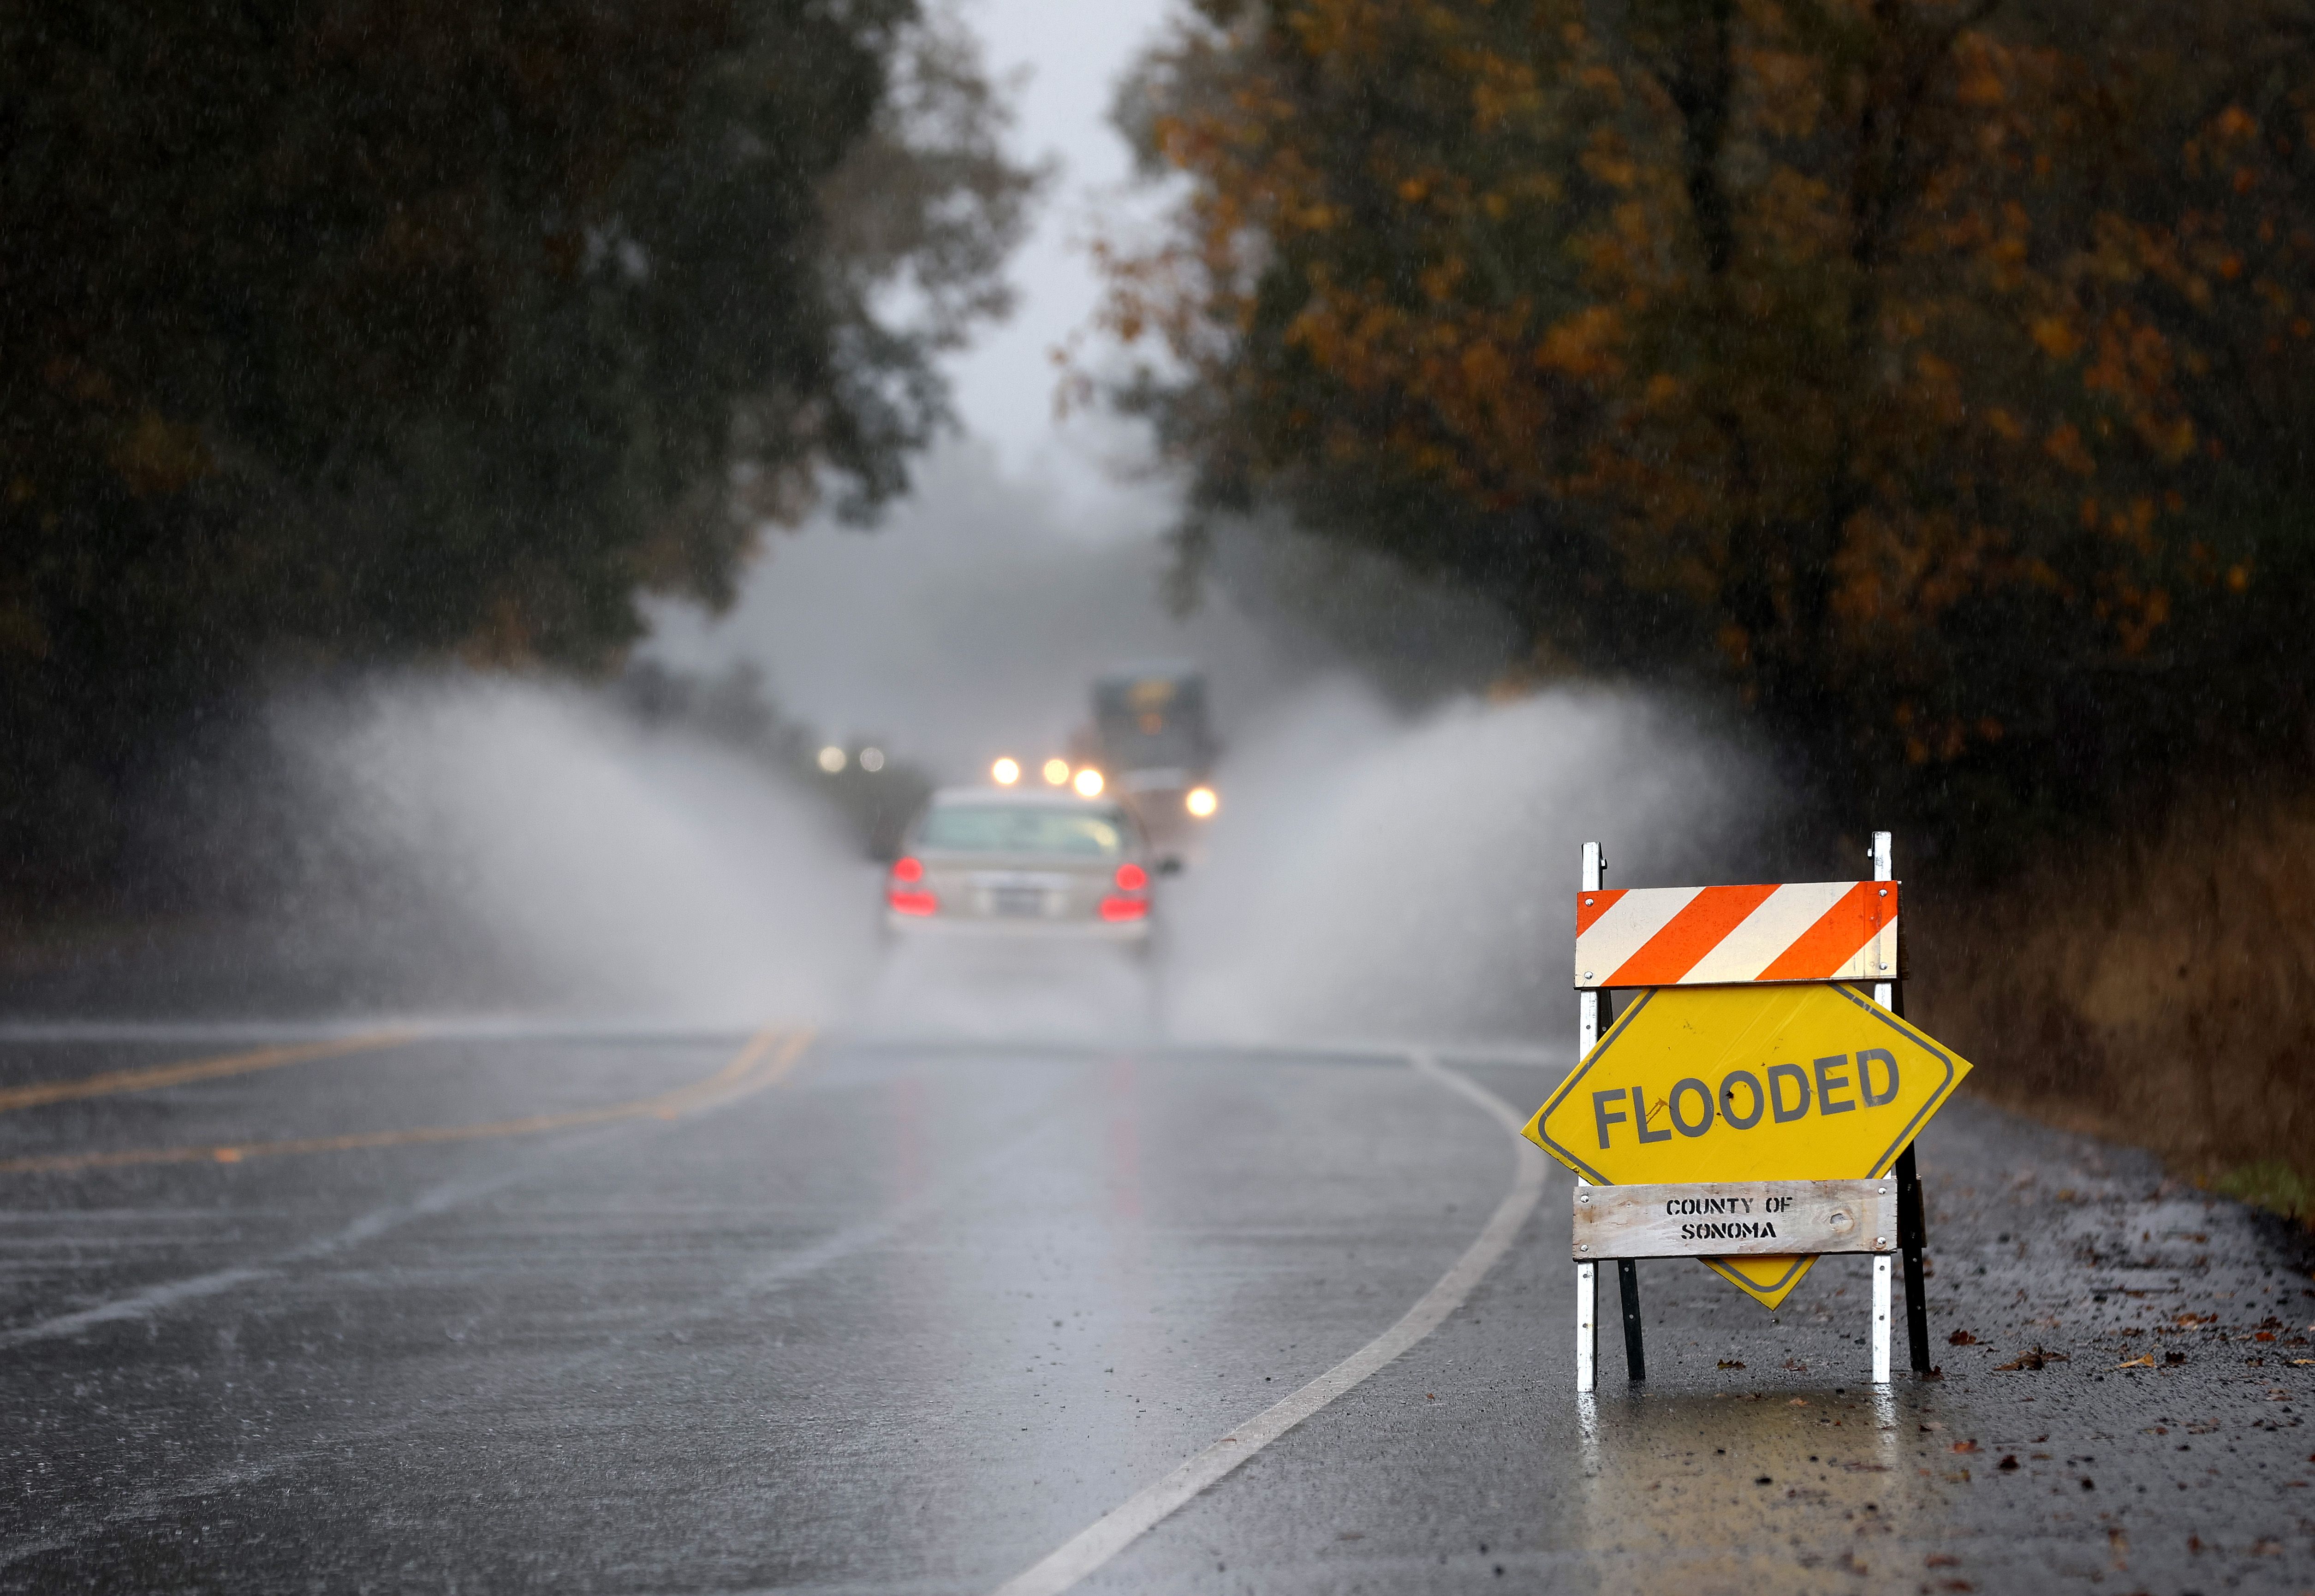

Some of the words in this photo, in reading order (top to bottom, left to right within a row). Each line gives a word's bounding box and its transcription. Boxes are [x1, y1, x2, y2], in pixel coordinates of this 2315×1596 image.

[1592, 1048, 1900, 1149] FLOODED
[1666, 1198, 1752, 1216] COUNTY
[1766, 1197, 1793, 1213] OF
[1681, 1222, 1777, 1240] SONOMA
